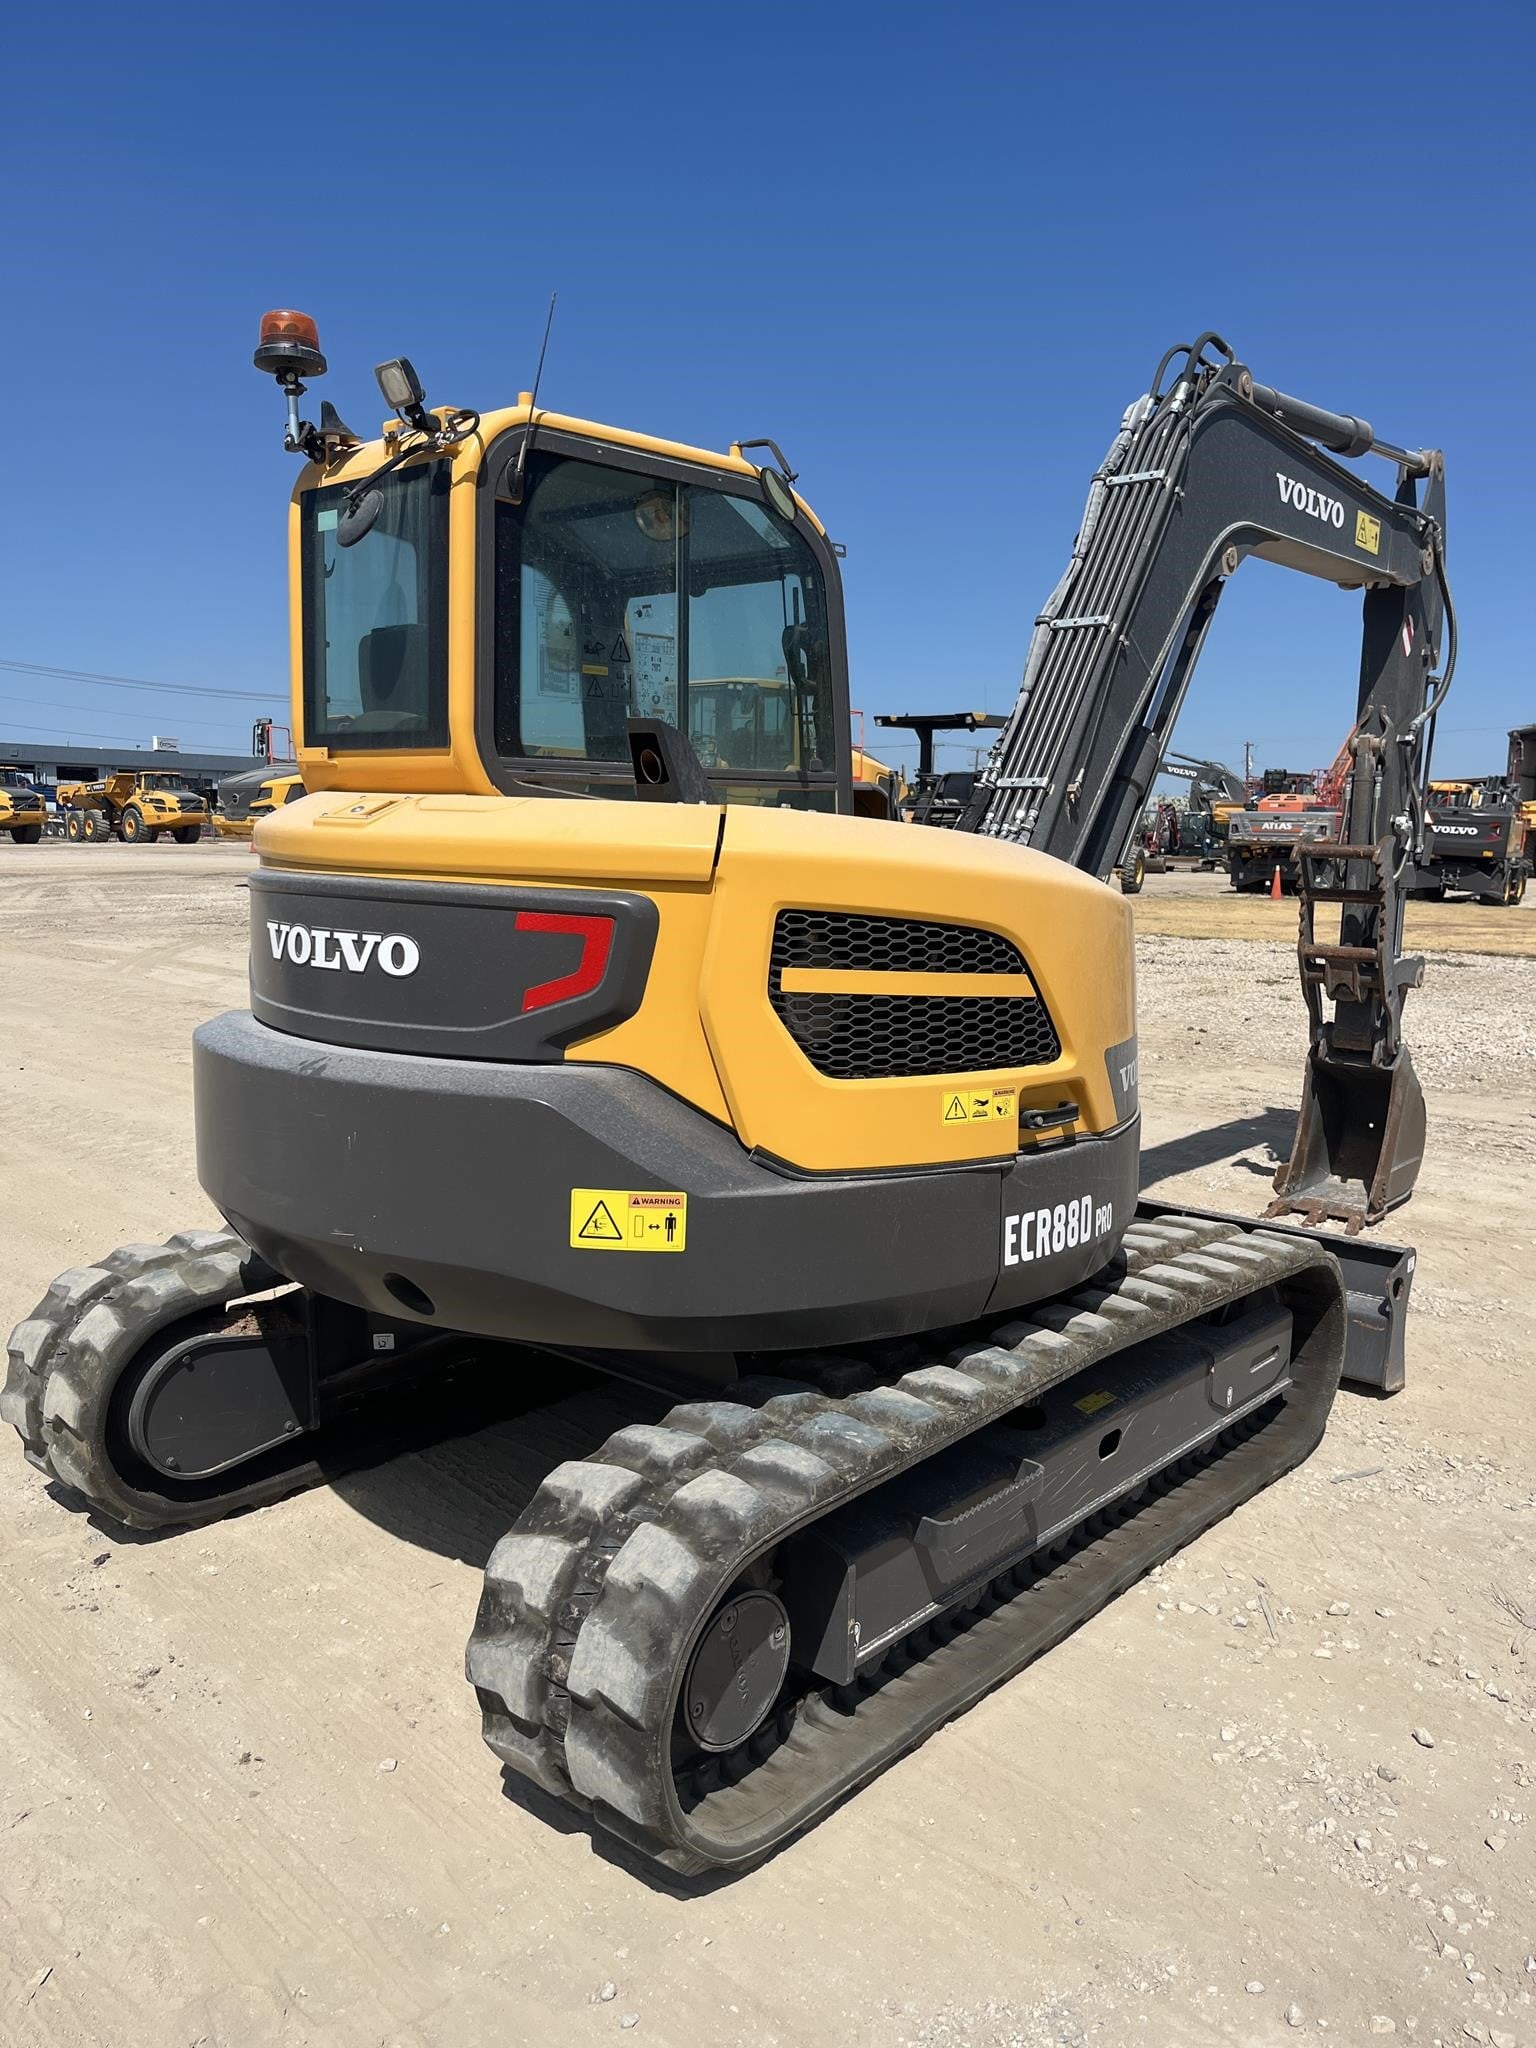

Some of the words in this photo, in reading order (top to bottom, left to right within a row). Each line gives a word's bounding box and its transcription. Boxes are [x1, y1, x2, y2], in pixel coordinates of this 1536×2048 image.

[1276, 472, 1345, 529] VOLVO
[1166, 766, 1198, 777] VOLVO
[1261, 822, 1293, 830] ATLAS
[1431, 825, 1479, 836] VOLVO
[266, 921, 420, 976] VOLVO
[1120, 1060, 1137, 1092] VO
[641, 1198, 681, 1206] WARNING
[1004, 1194, 1092, 1266] ECR88D
[1096, 1202, 1113, 1238] PRO
